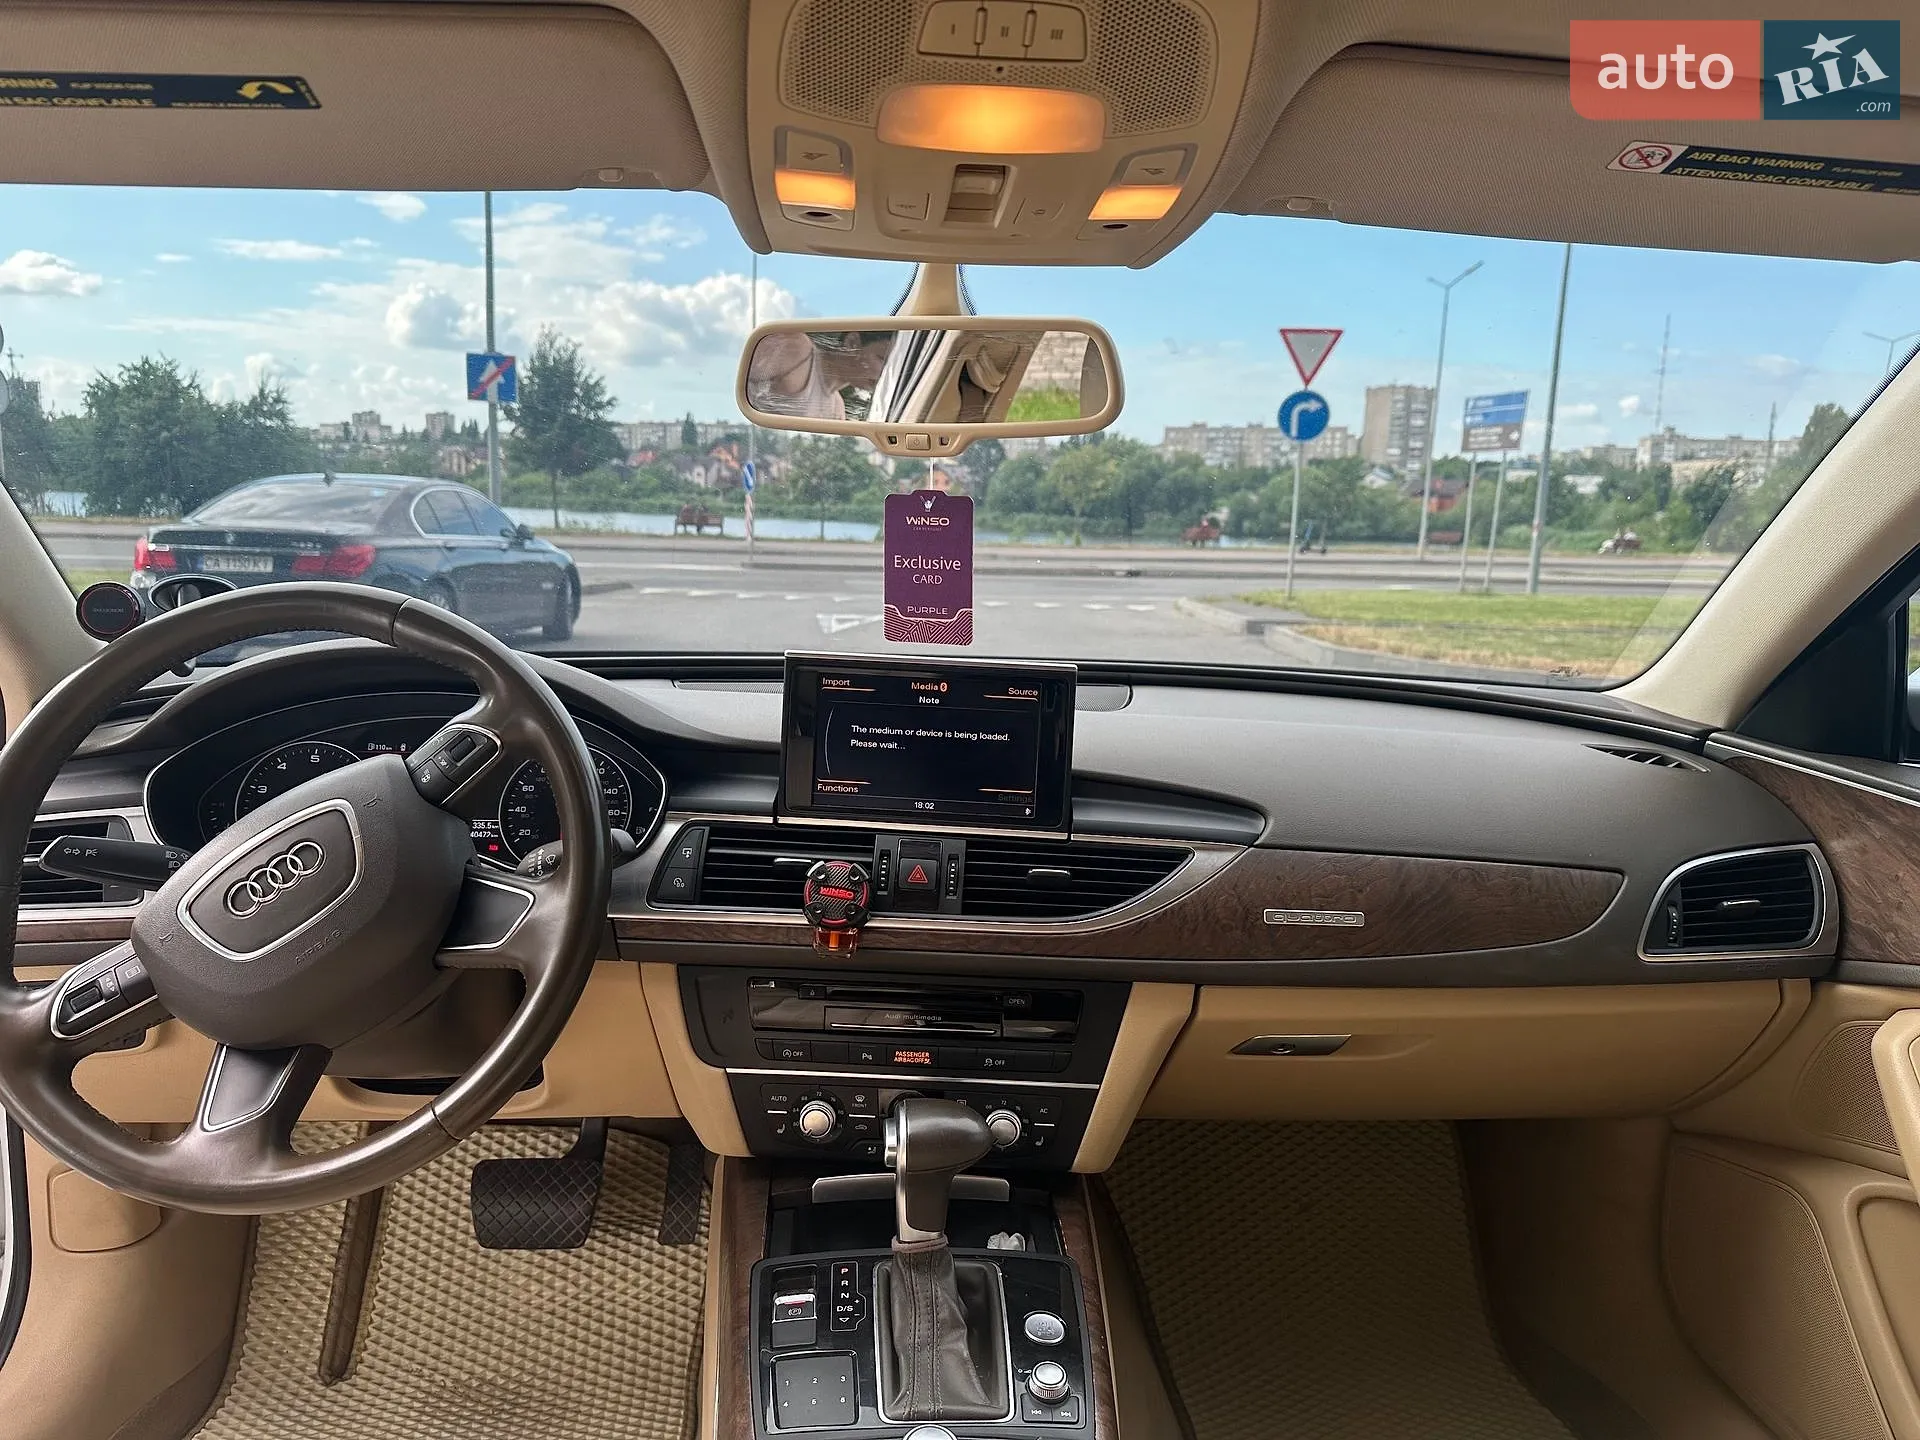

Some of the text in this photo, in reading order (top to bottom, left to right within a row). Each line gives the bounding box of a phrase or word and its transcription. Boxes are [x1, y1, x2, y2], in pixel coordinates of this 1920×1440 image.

[1686, 150, 1715, 162] AIR
[1716, 153, 1750, 165] BAG
[1751, 156, 1825, 172] WARNING
[1671, 166, 1752, 182] ATTENTION
[1752, 173, 1786, 185] SAC
[1786, 176, 1876, 192] GONFLABLE
[894, 554, 962, 571] Exclusive
[912, 574, 943, 585] CARD
[907, 605, 949, 615] PURPLE
[822, 677, 850, 688] Import
[911, 682, 938, 692] Media
[1008, 687, 1039, 697] Source
[918, 696, 940, 704] Note
[851, 725, 868, 734] The
[869, 726, 903, 736] medium
[916, 728, 943, 738] device
[944, 730, 952, 738] is
[954, 730, 978, 741] being
[979, 732, 1010, 742] loaded.
[850, 740, 906, 750] Please wait...
[310, 754, 320, 763] 5
[277, 762, 287, 770] 4
[257, 785, 268, 793] 3
[817, 784, 858, 794] Functions
[914, 801, 935, 810] 18:02
[819, 886, 854, 899] WINSO
[1272, 912, 1357, 924] quattro
[903, 1014, 942, 1022] multimedia
